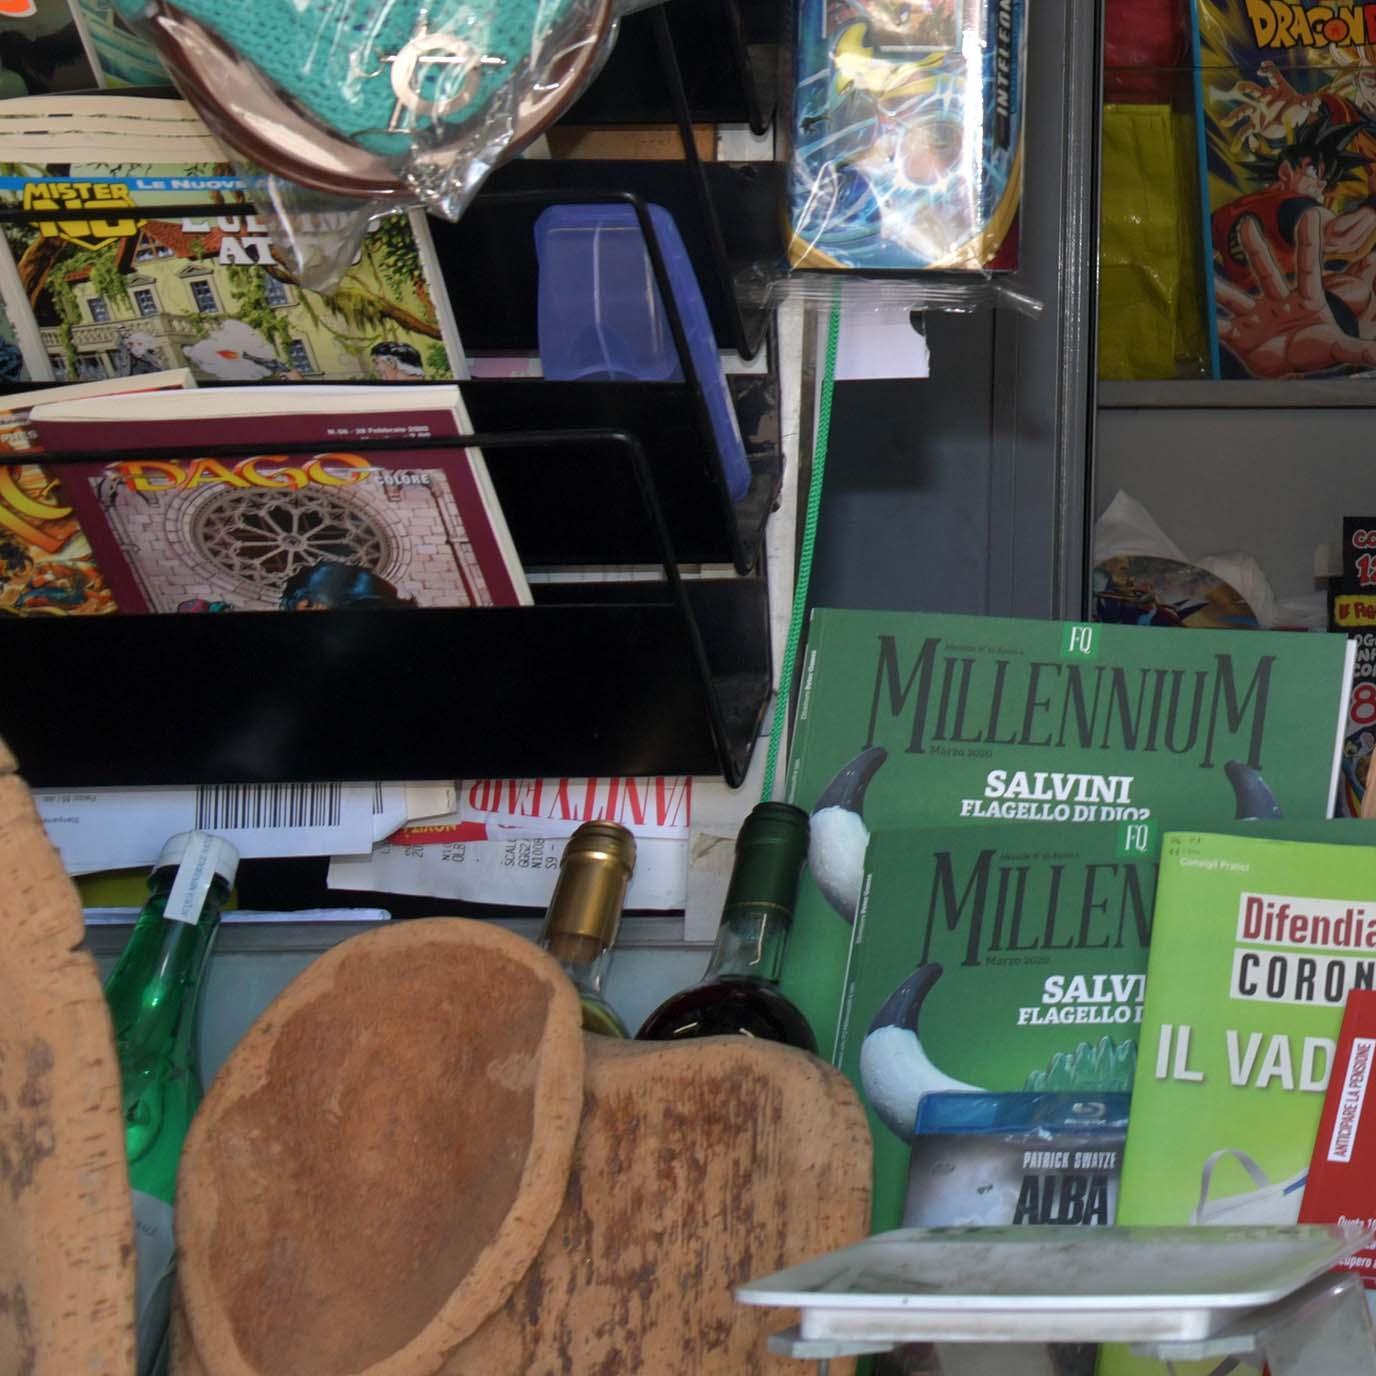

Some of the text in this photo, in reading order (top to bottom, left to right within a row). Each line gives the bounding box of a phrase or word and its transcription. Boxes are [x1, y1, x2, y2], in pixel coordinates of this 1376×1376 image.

[23, 181, 130, 203] MISTER
[861, 634, 1278, 771] MILLENNIUM
[984, 769, 1134, 805] SALVINI
[960, 798, 1098, 821] FLAGELLO DI
[1155, 1024, 1205, 1082] IL
